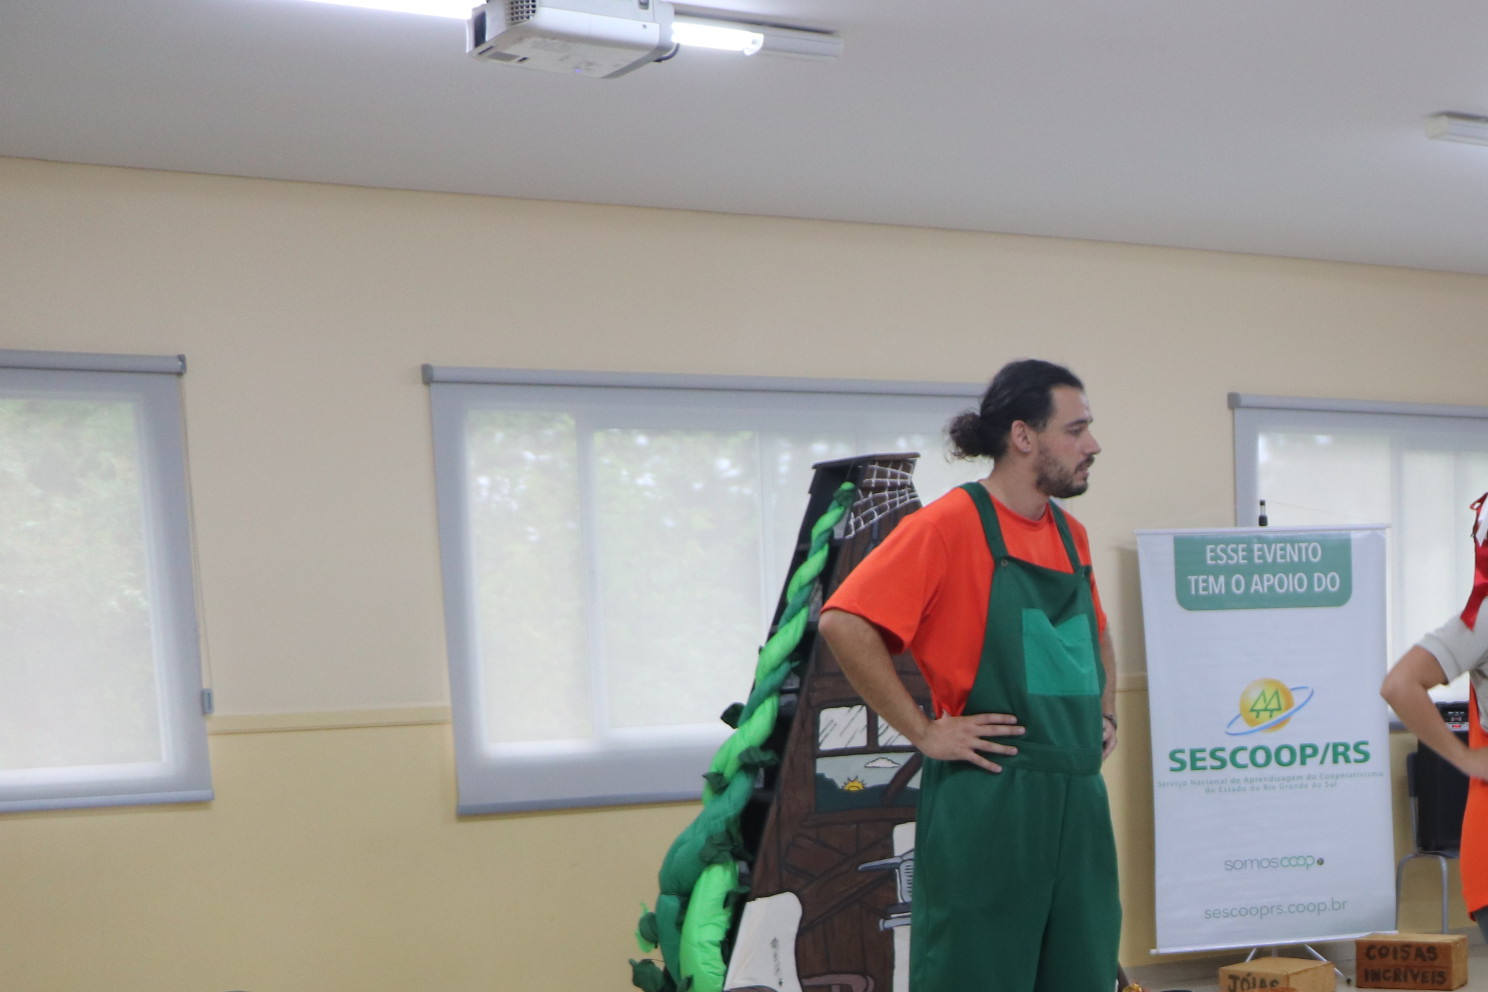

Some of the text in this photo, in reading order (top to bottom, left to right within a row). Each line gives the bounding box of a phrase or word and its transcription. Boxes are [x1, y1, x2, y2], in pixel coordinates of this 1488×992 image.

[1206, 541, 1322, 565] ESSE EVENTO
[1187, 571, 1341, 596] TEM O APOIO DO
[1168, 740, 1372, 773] SESCOOP/RS
[1157, 779, 1188, 789] Serviço
[1190, 777, 1228, 786] Nacional
[1243, 774, 1303, 784] Aprendizagem
[1306, 773, 1317, 781] do
[1319, 771, 1385, 780] Cooperativismo
[1204, 780, 1338, 794] do Estado do Rio Grande do Sul
[1204, 897, 1348, 921] sescooprs.coop.br
[1365, 944, 1439, 962] COISAS
